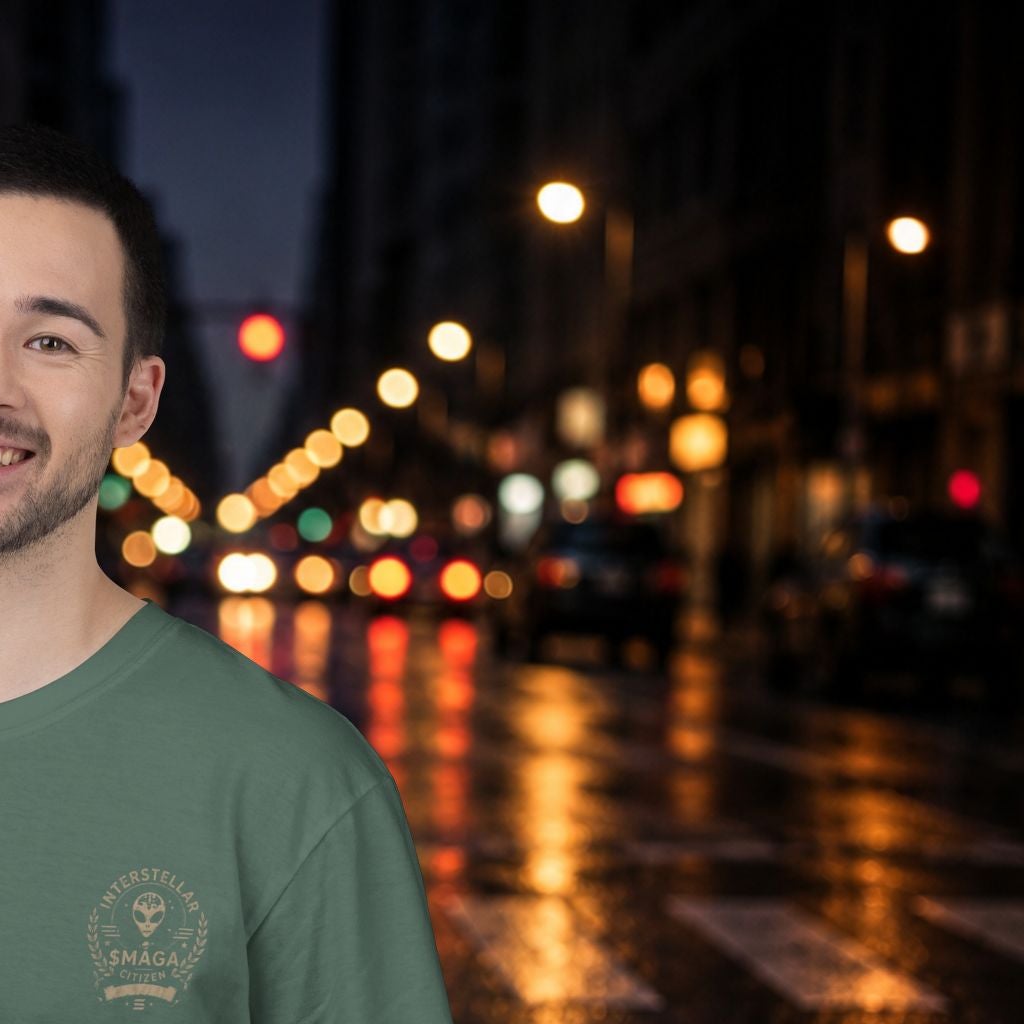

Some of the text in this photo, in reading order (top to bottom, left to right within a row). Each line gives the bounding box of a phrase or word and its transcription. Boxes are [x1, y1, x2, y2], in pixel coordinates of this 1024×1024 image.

[100, 868, 199, 913] INTERSTELLAR
[109, 949, 179, 967] $MAGA
[119, 969, 166, 983] CITIZEN
